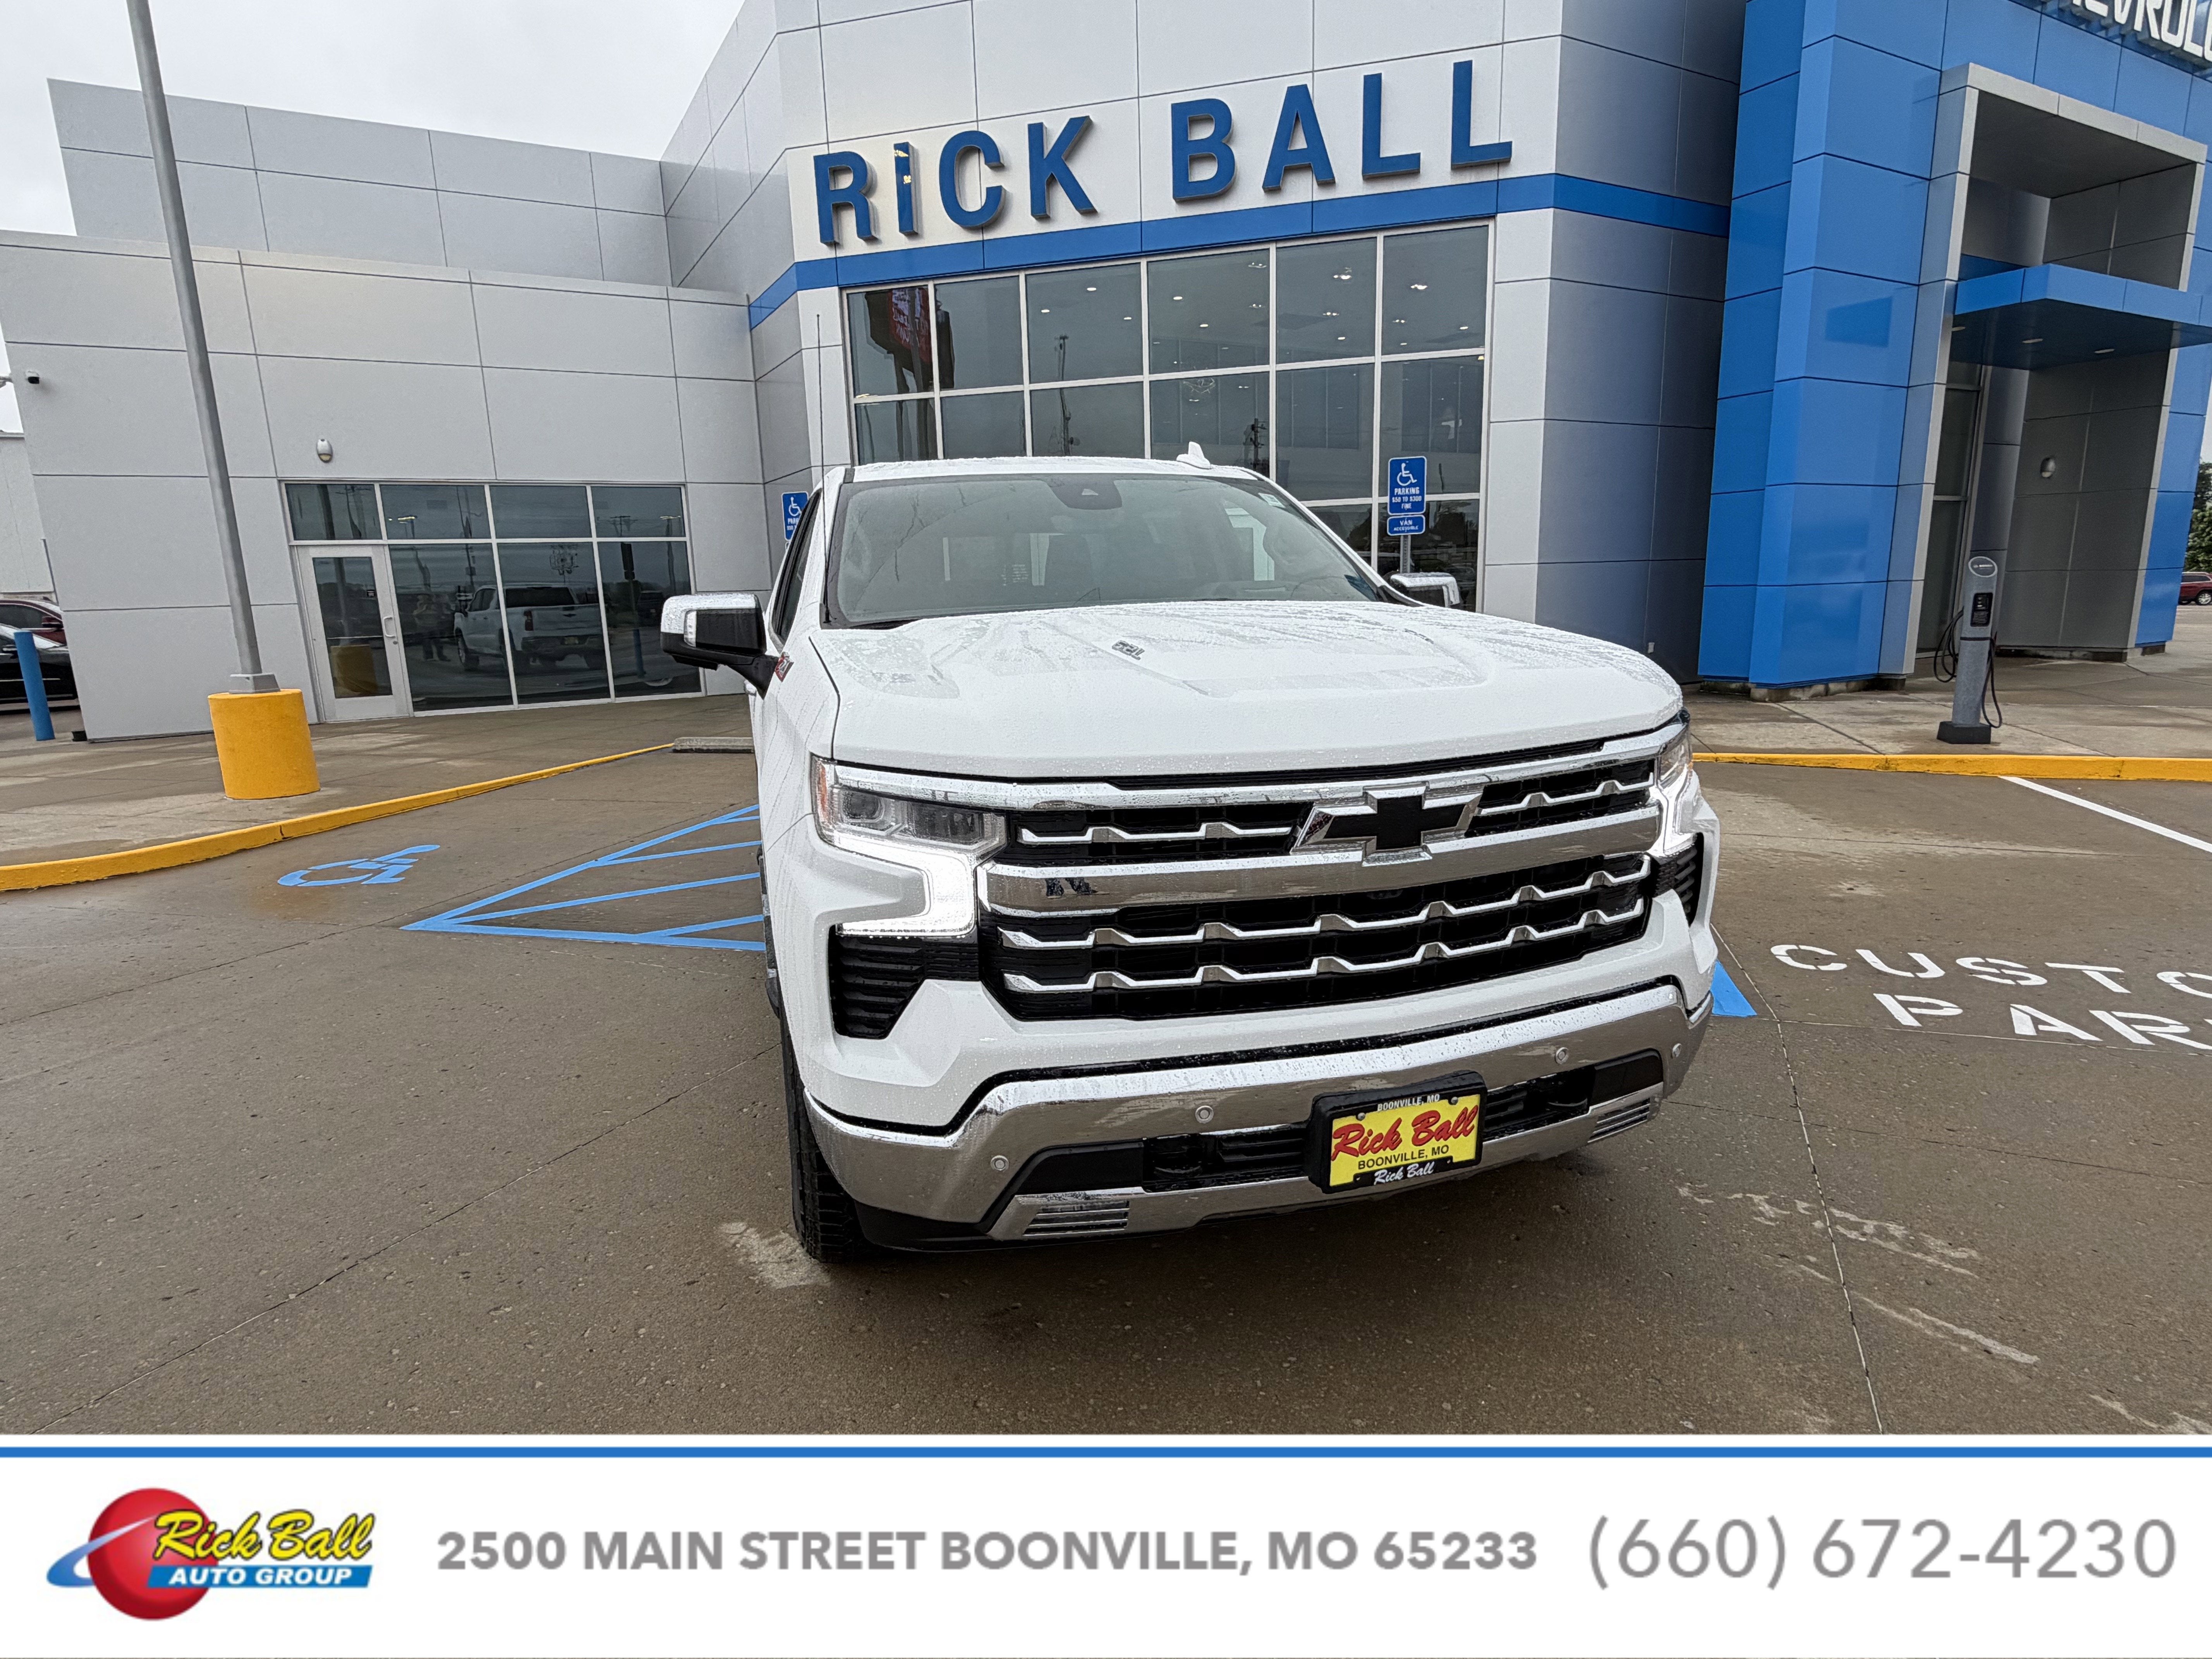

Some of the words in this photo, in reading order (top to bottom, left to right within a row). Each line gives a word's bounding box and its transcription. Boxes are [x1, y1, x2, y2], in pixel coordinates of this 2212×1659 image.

[814, 115, 1097, 245] RICK
[1171, 60, 1513, 202] BALL
[1395, 487, 1419, 495] PARKING
[1873, 993, 2212, 1050] PAR
[1377, 1096, 1424, 1112] BOONVILLE,
[1427, 1093, 1440, 1103] MO
[1331, 1117, 1403, 1161] Rick
[1411, 1105, 1479, 1147] Ball
[1358, 1148, 1428, 1170] BOONVILLE,
[1431, 1144, 1449, 1156] MO
[1374, 1166, 1404, 1185] Rick
[1406, 1161, 1435, 1178] Ball
